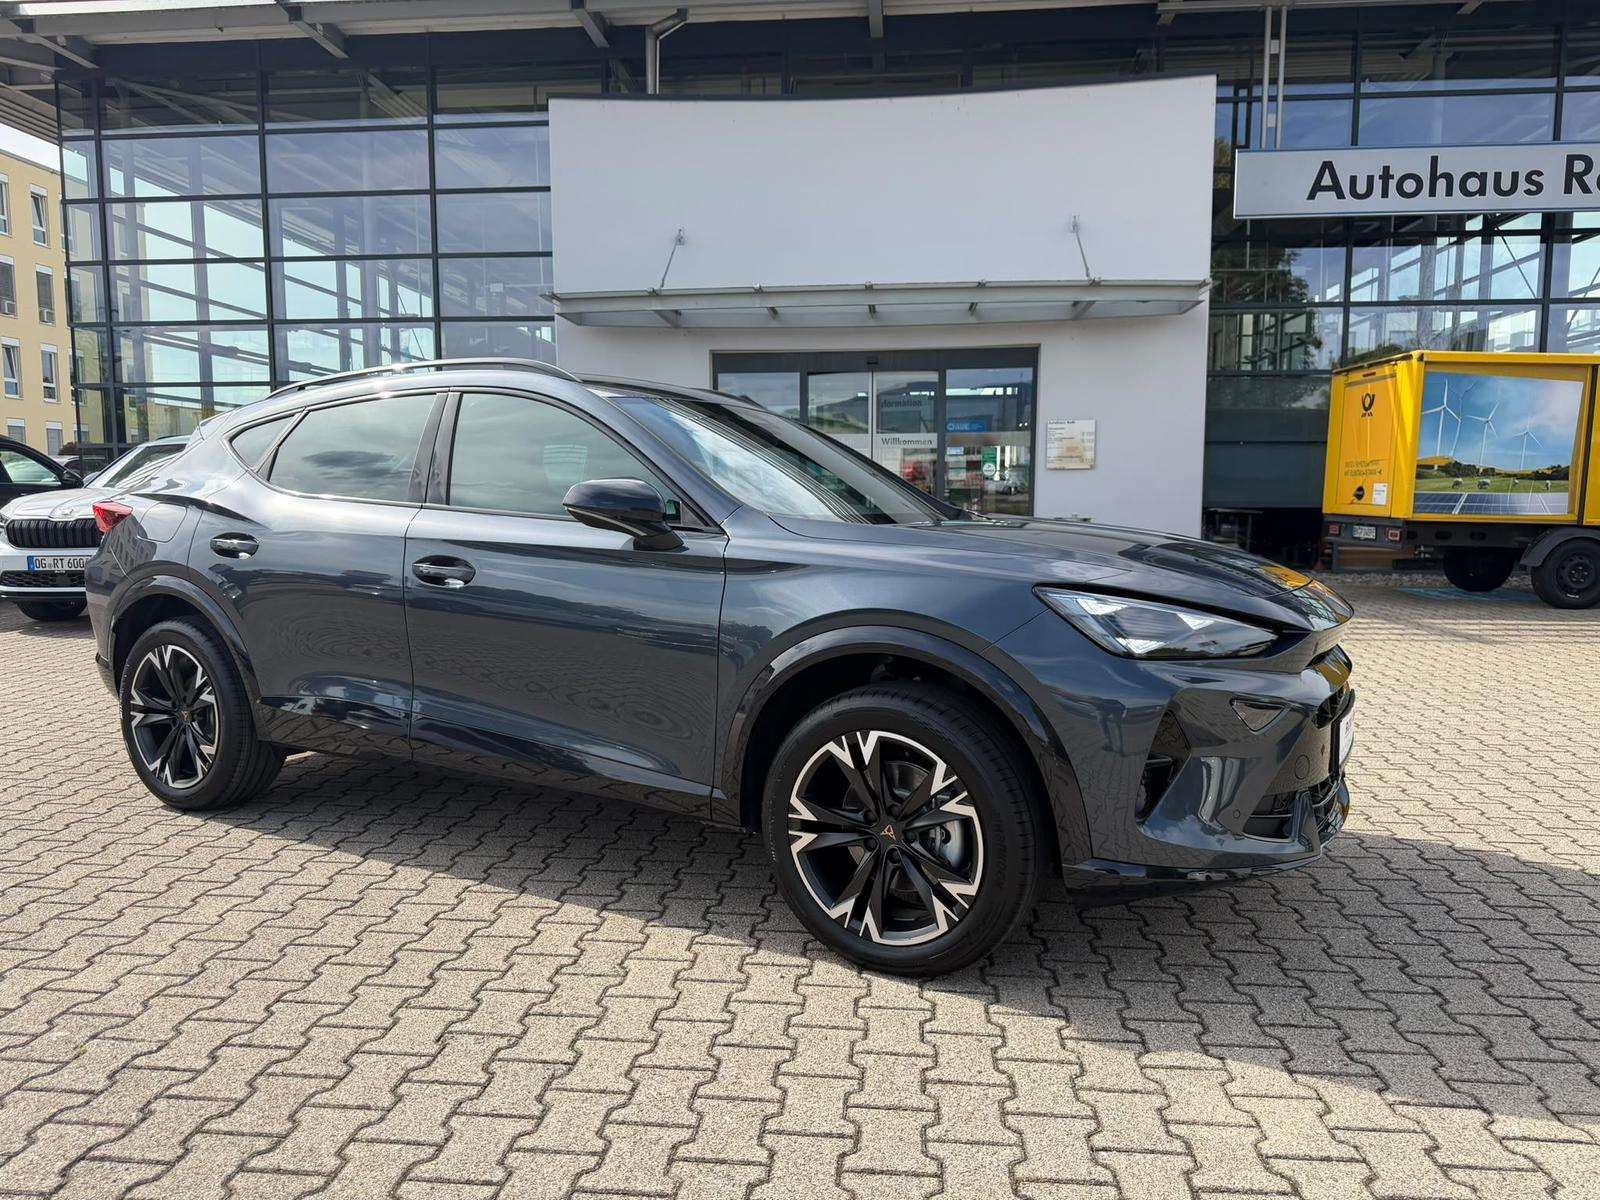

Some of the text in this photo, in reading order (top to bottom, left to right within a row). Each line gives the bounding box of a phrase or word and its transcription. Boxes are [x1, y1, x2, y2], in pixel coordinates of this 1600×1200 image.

[1306, 154, 1600, 201] Autohaus R
[881, 437, 933, 445] Willkommen
[35, 558, 47, 569] OG
[53, 558, 65, 569] RT
